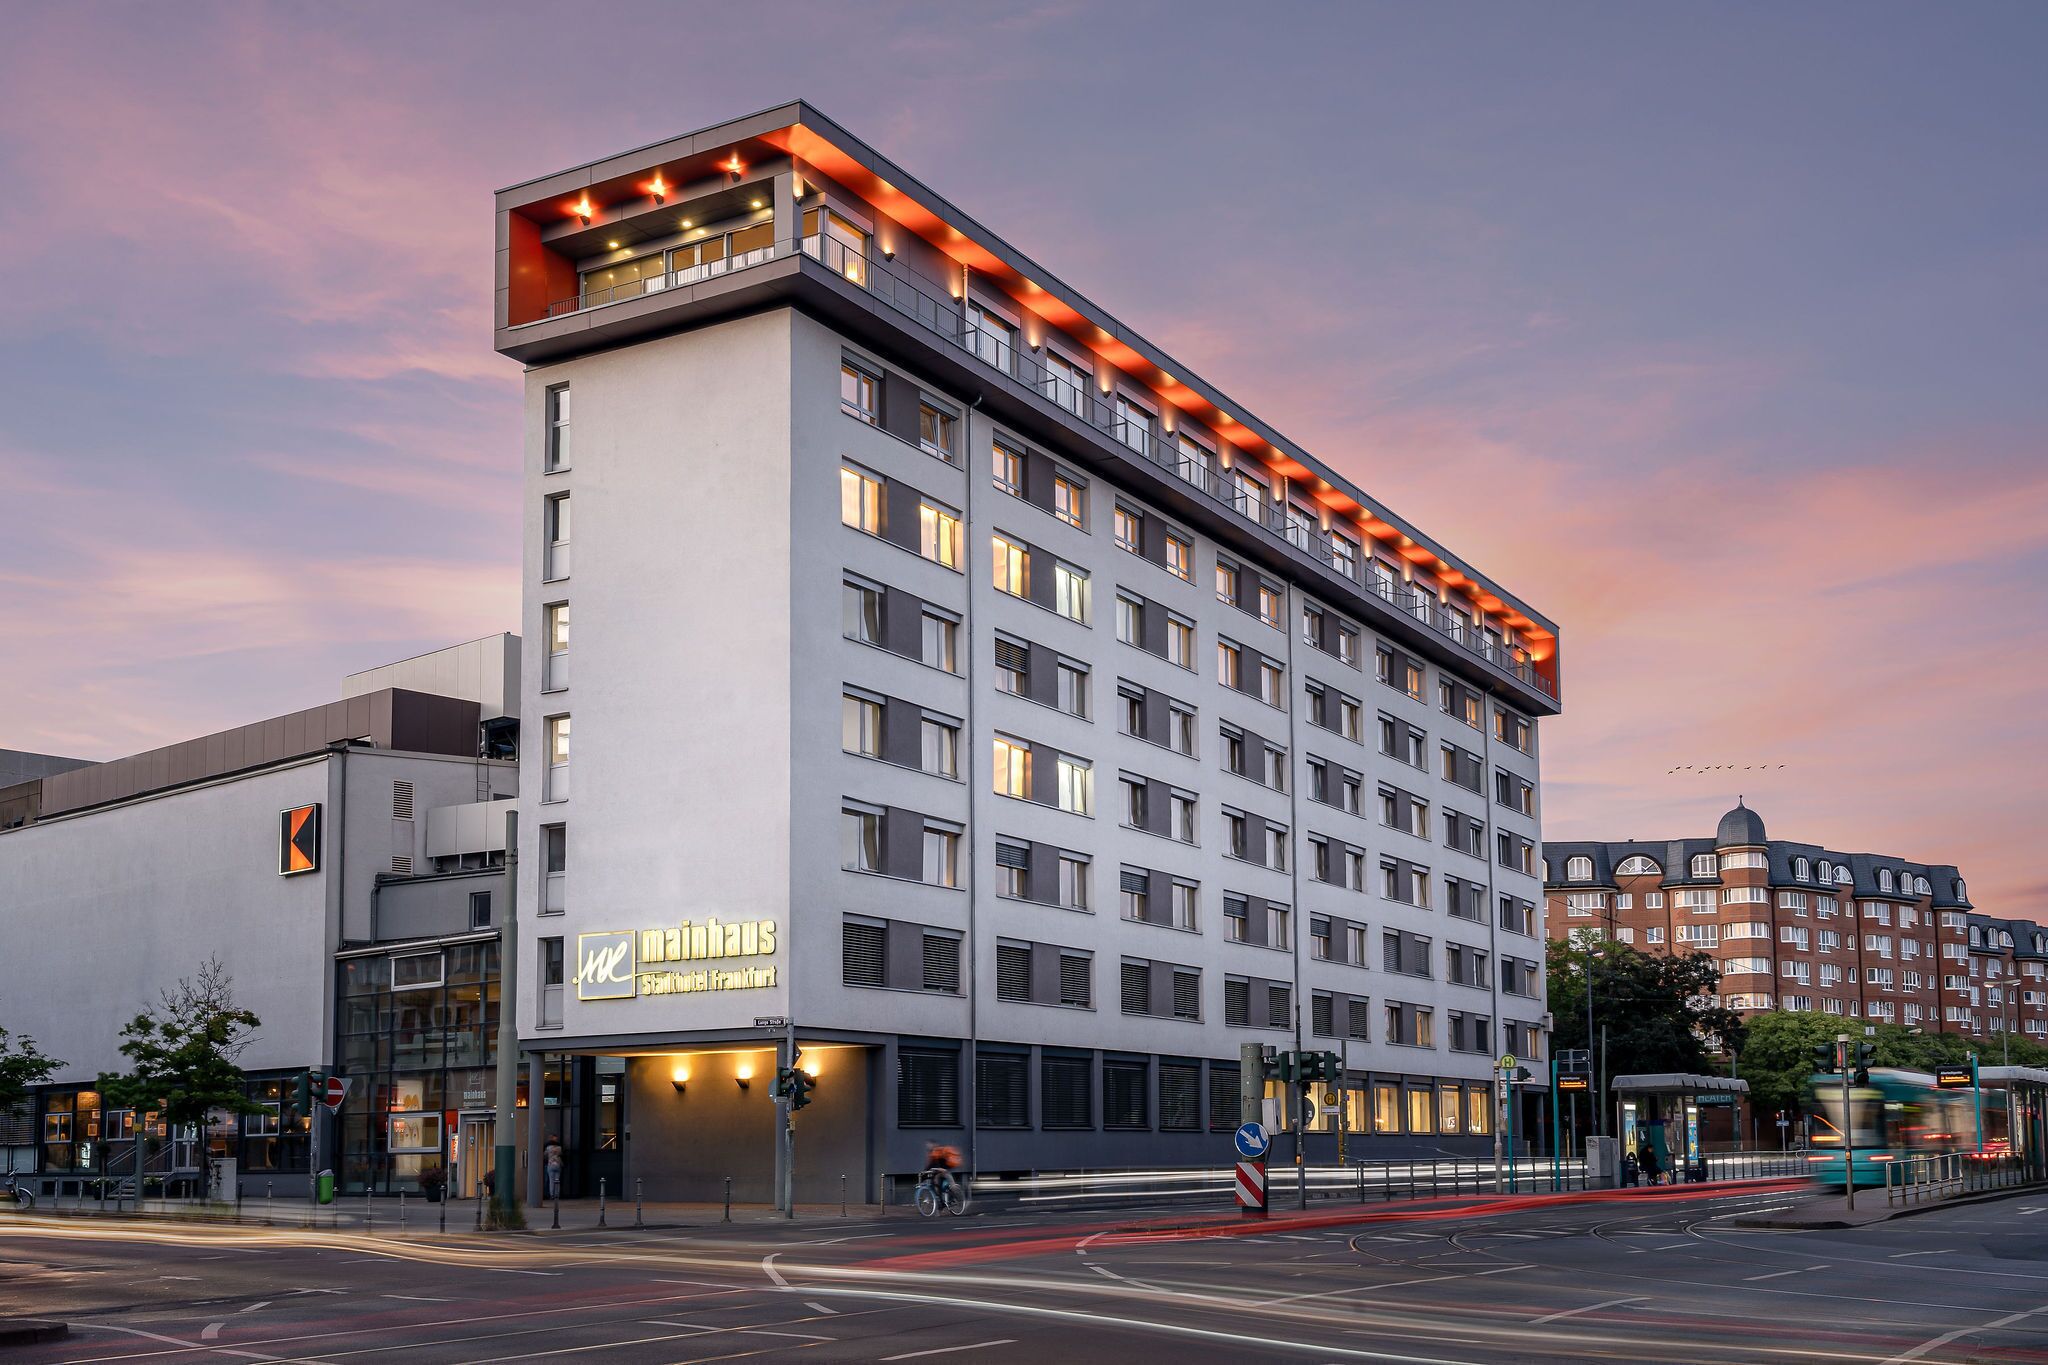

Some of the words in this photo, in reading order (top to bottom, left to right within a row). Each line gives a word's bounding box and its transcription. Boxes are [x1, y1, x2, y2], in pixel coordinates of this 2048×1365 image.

[642, 917, 776, 962] mainhaus
[642, 970, 709, 994] Stadthotel
[711, 966, 777, 990] Frankfurt
